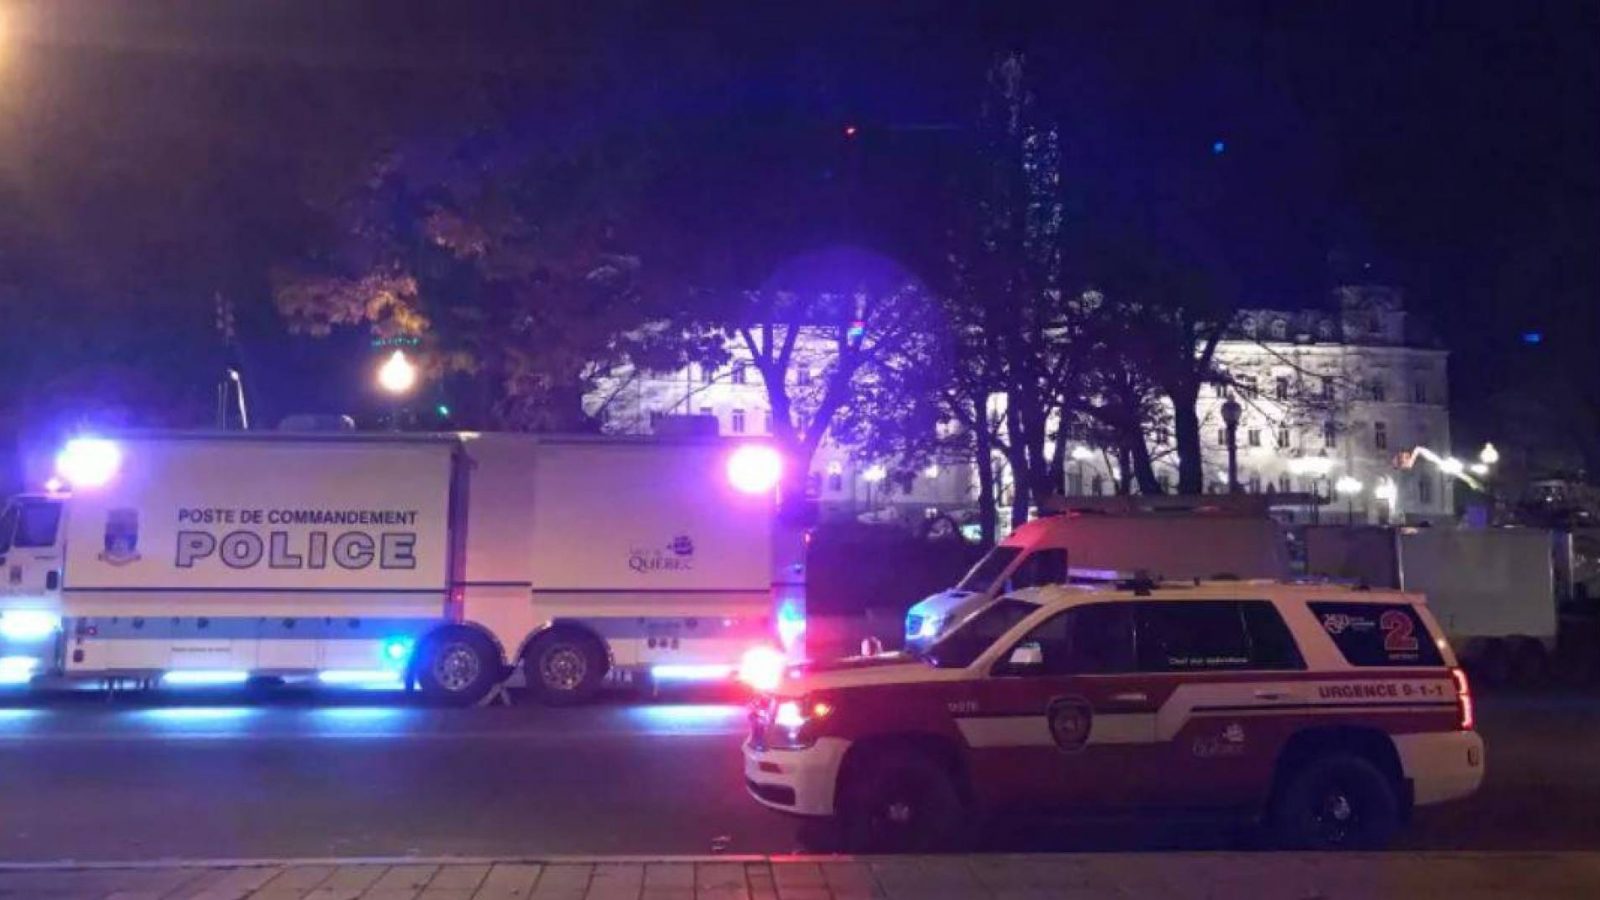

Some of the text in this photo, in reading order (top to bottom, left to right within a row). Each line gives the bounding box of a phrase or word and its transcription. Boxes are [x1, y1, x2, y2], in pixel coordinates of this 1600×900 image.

[178, 509, 418, 525] POSTE DE COMMANDEMENT
[175, 530, 417, 570] POLICE
[1380, 609, 1419, 651] 2
[1319, 684, 1398, 699] URGENCE
